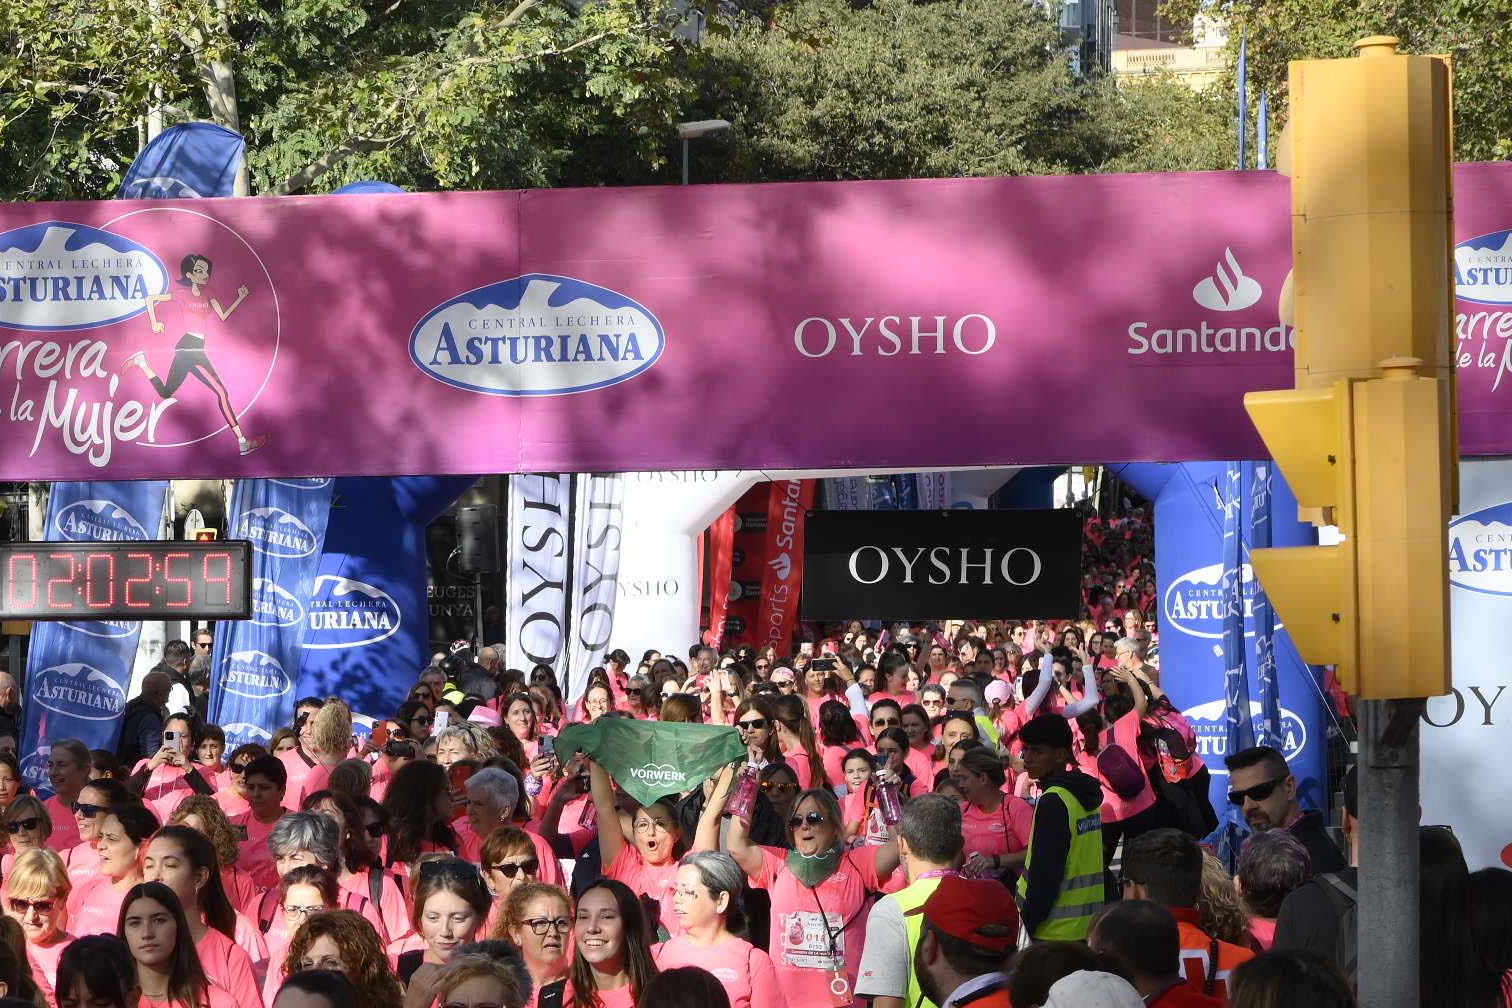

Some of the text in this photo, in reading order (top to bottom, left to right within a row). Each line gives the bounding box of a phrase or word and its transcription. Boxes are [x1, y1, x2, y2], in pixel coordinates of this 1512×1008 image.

[71, 258, 143, 270] LECHERA
[468, 314, 637, 331] CENTRAL LECHERA
[794, 313, 997, 358] OYSHO
[429, 320, 645, 366] ASTURIANA
[1478, 341, 1496, 368] la
[9, 381, 35, 422] la
[29, 372, 178, 468] Mujer
[8, 552, 234, 608] 02:02:59
[848, 545, 1042, 586] OYSHO
[37, 678, 120, 713] ASTURIANA
[631, 768, 686, 782] VORWERK
